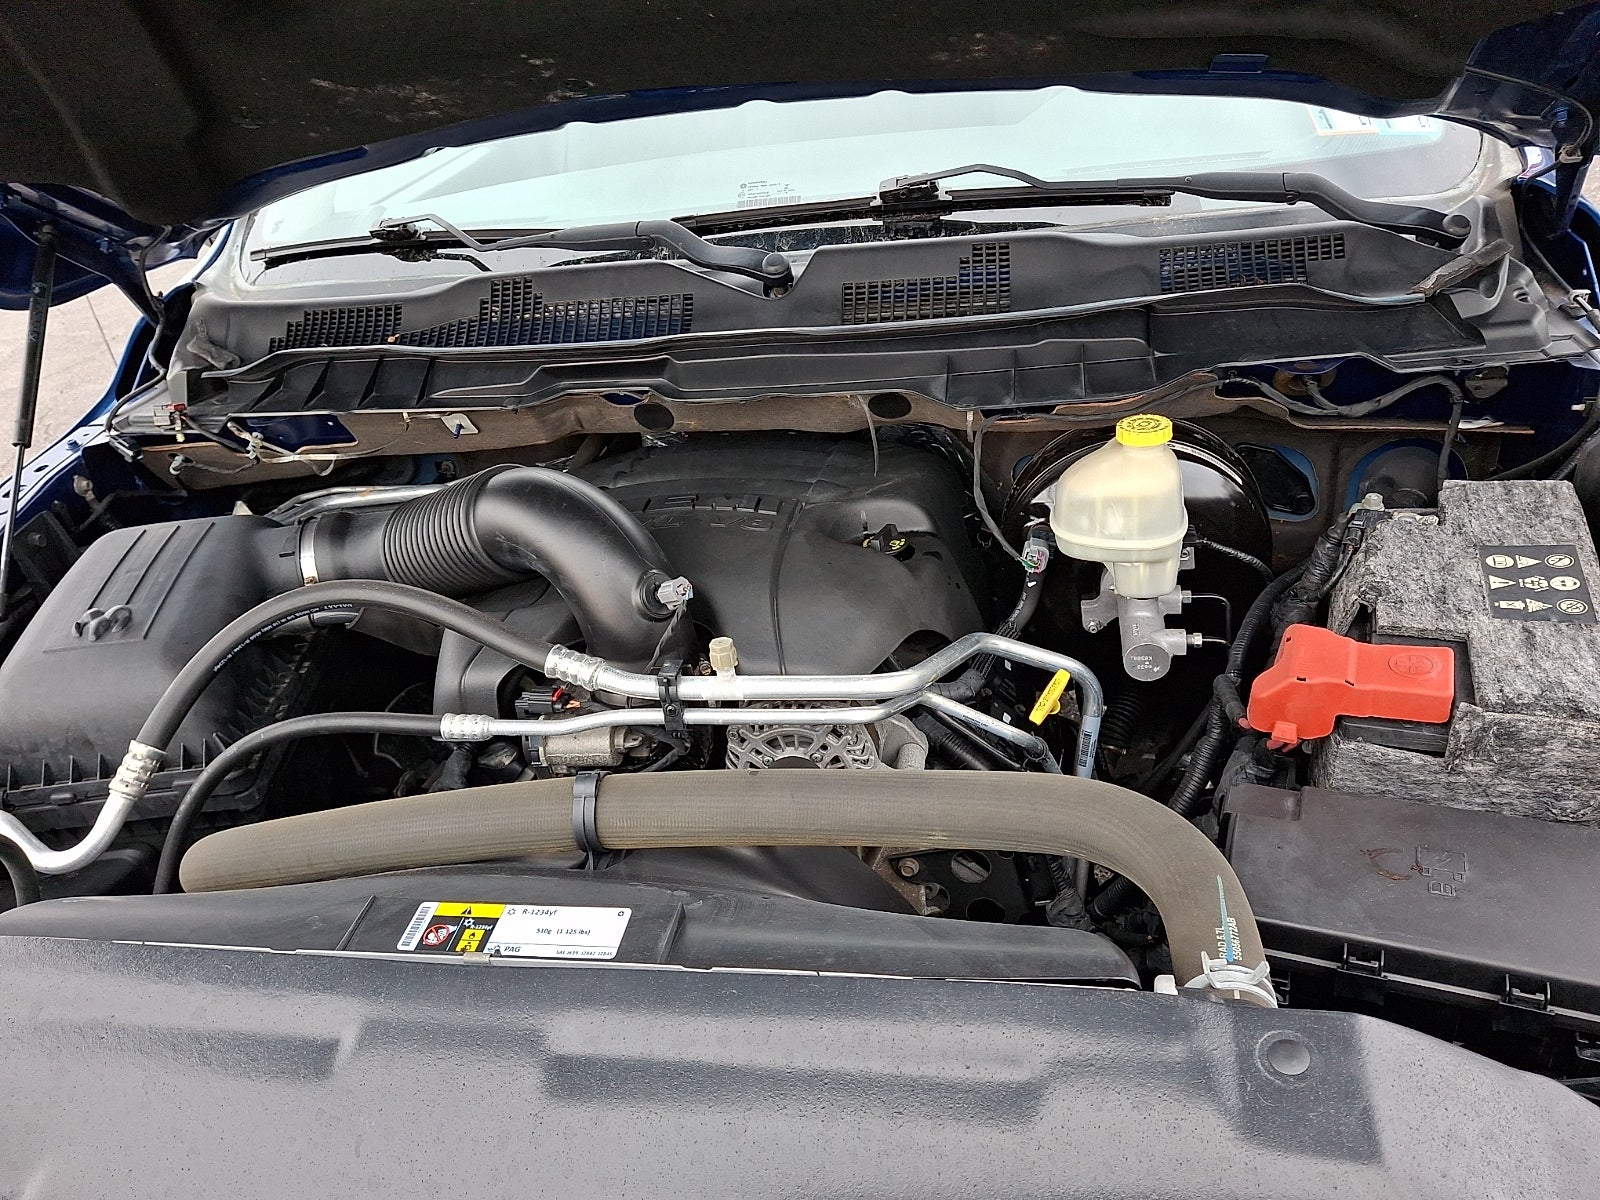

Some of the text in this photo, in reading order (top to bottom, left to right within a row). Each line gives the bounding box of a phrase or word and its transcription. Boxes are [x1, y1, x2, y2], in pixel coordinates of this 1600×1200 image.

[521, 908, 558, 916] R-1234yf
[1215, 926, 1227, 959] RAD 5.7L
[1226, 917, 1242, 961] 55056772AB
